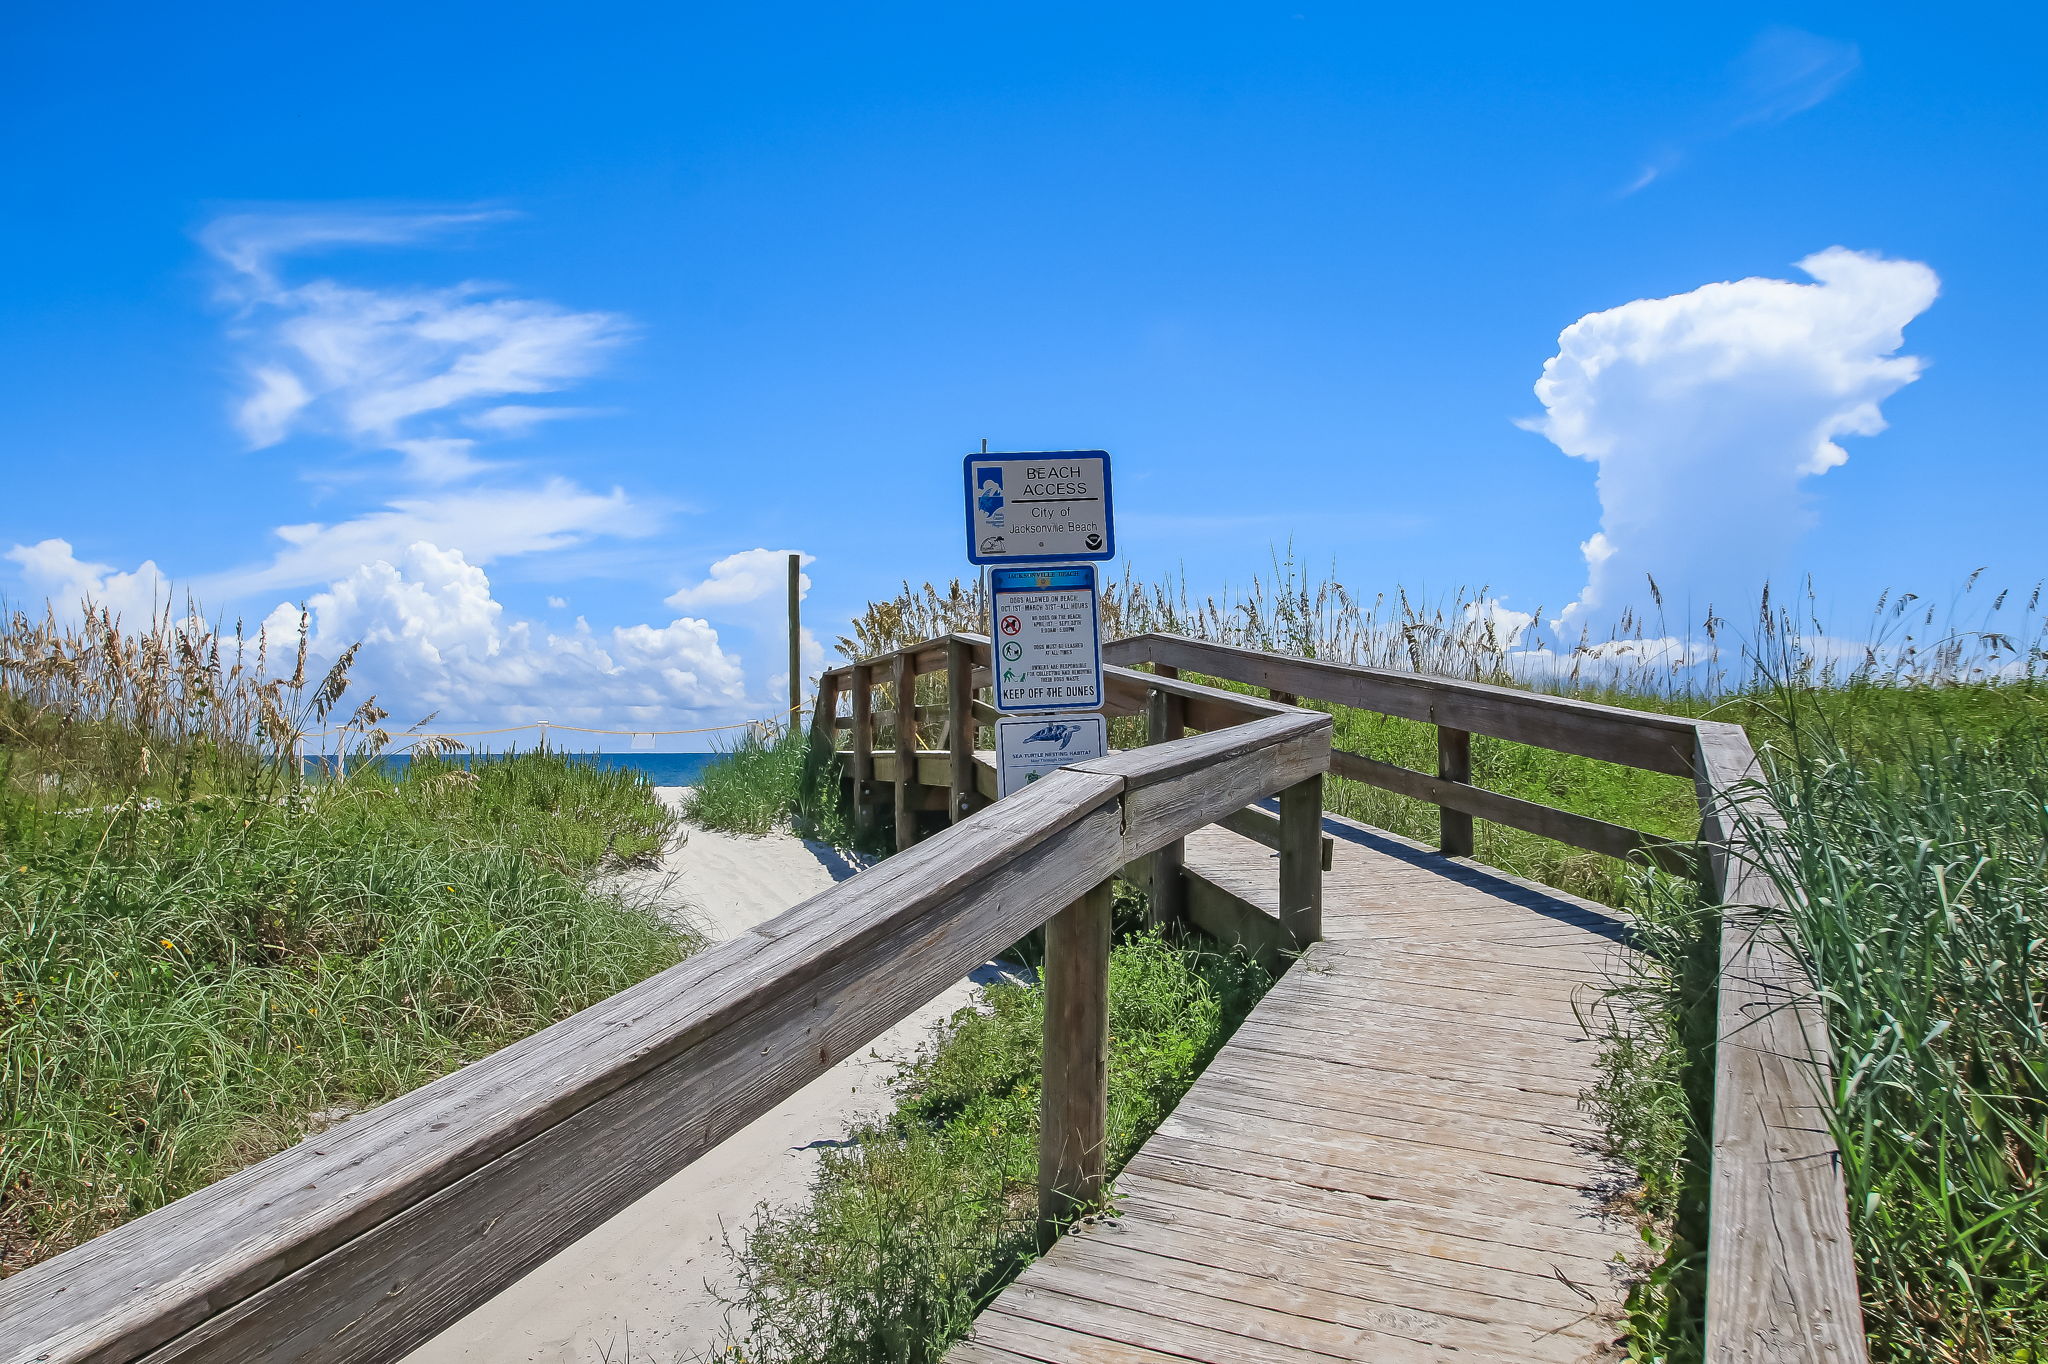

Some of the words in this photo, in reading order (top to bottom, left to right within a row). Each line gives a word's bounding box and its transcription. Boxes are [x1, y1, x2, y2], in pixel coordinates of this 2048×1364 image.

[1027, 466, 1080, 479] BEACH
[1023, 482, 1087, 495] ACCESS
[1032, 507, 1054, 519] City
[1060, 507, 1070, 516] of
[1010, 524, 1064, 534] Jacksonville
[1068, 522, 1097, 532] Beach
[1003, 689, 1024, 699] KEEP
[1028, 688, 1043, 698] OFF
[1046, 687, 1062, 697] THE
[1067, 686, 1094, 696] DUNES
